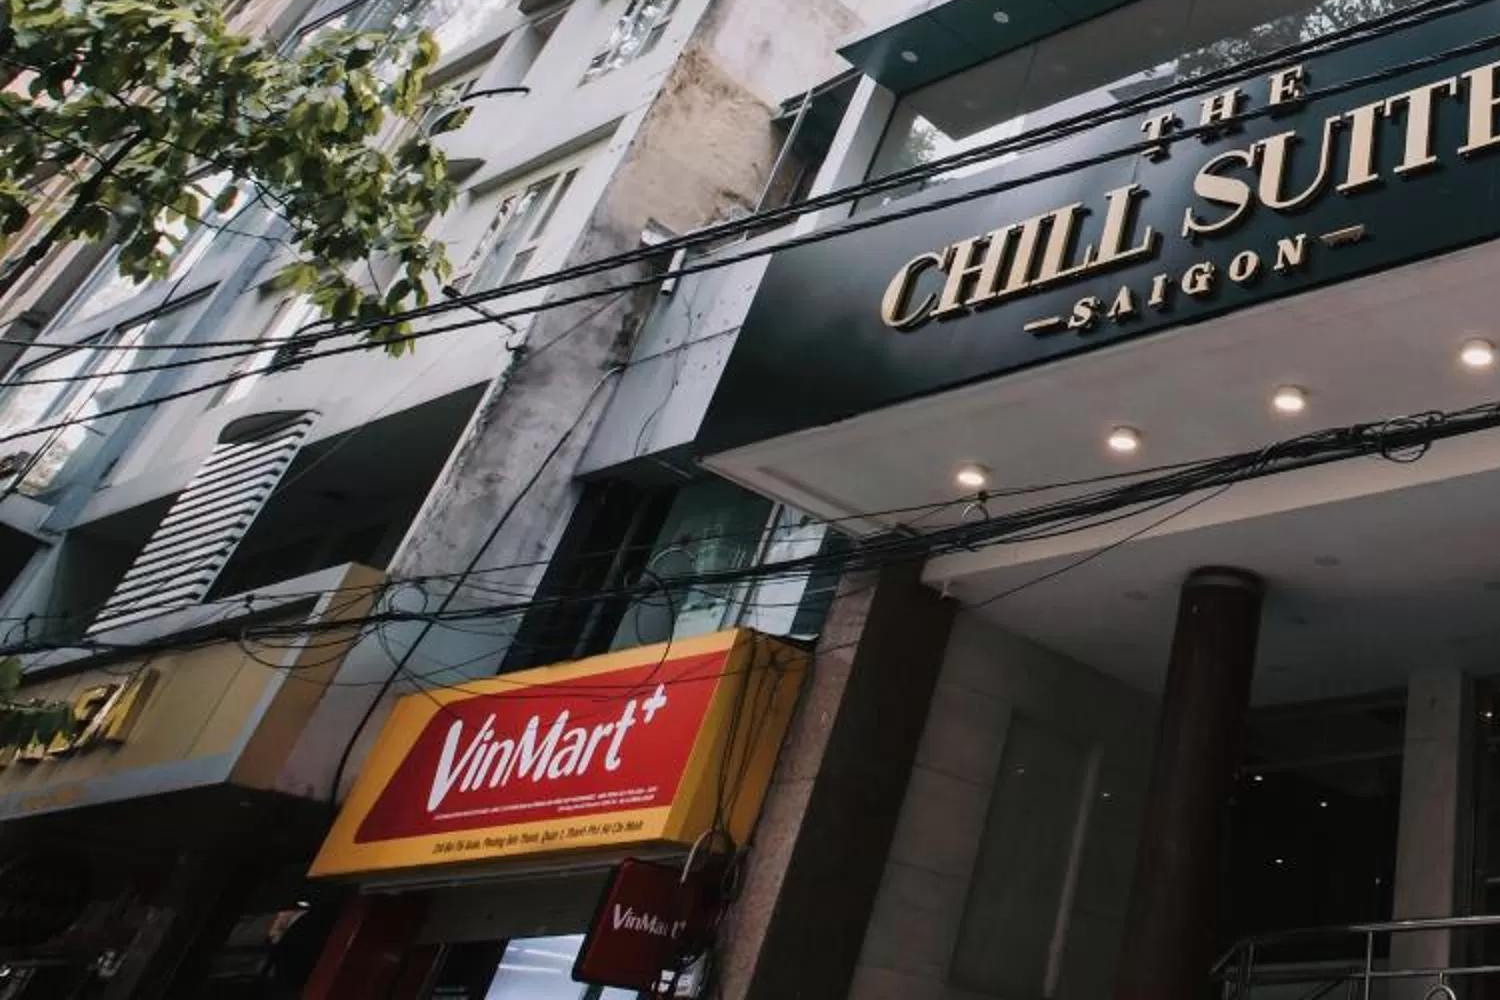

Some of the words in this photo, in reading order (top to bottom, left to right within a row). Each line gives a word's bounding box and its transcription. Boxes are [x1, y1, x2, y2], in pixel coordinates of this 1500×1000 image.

[1141, 63, 1308, 156] THE
[880, 182, 1157, 330] CHILL
[1067, 232, 1311, 331] SAIGON
